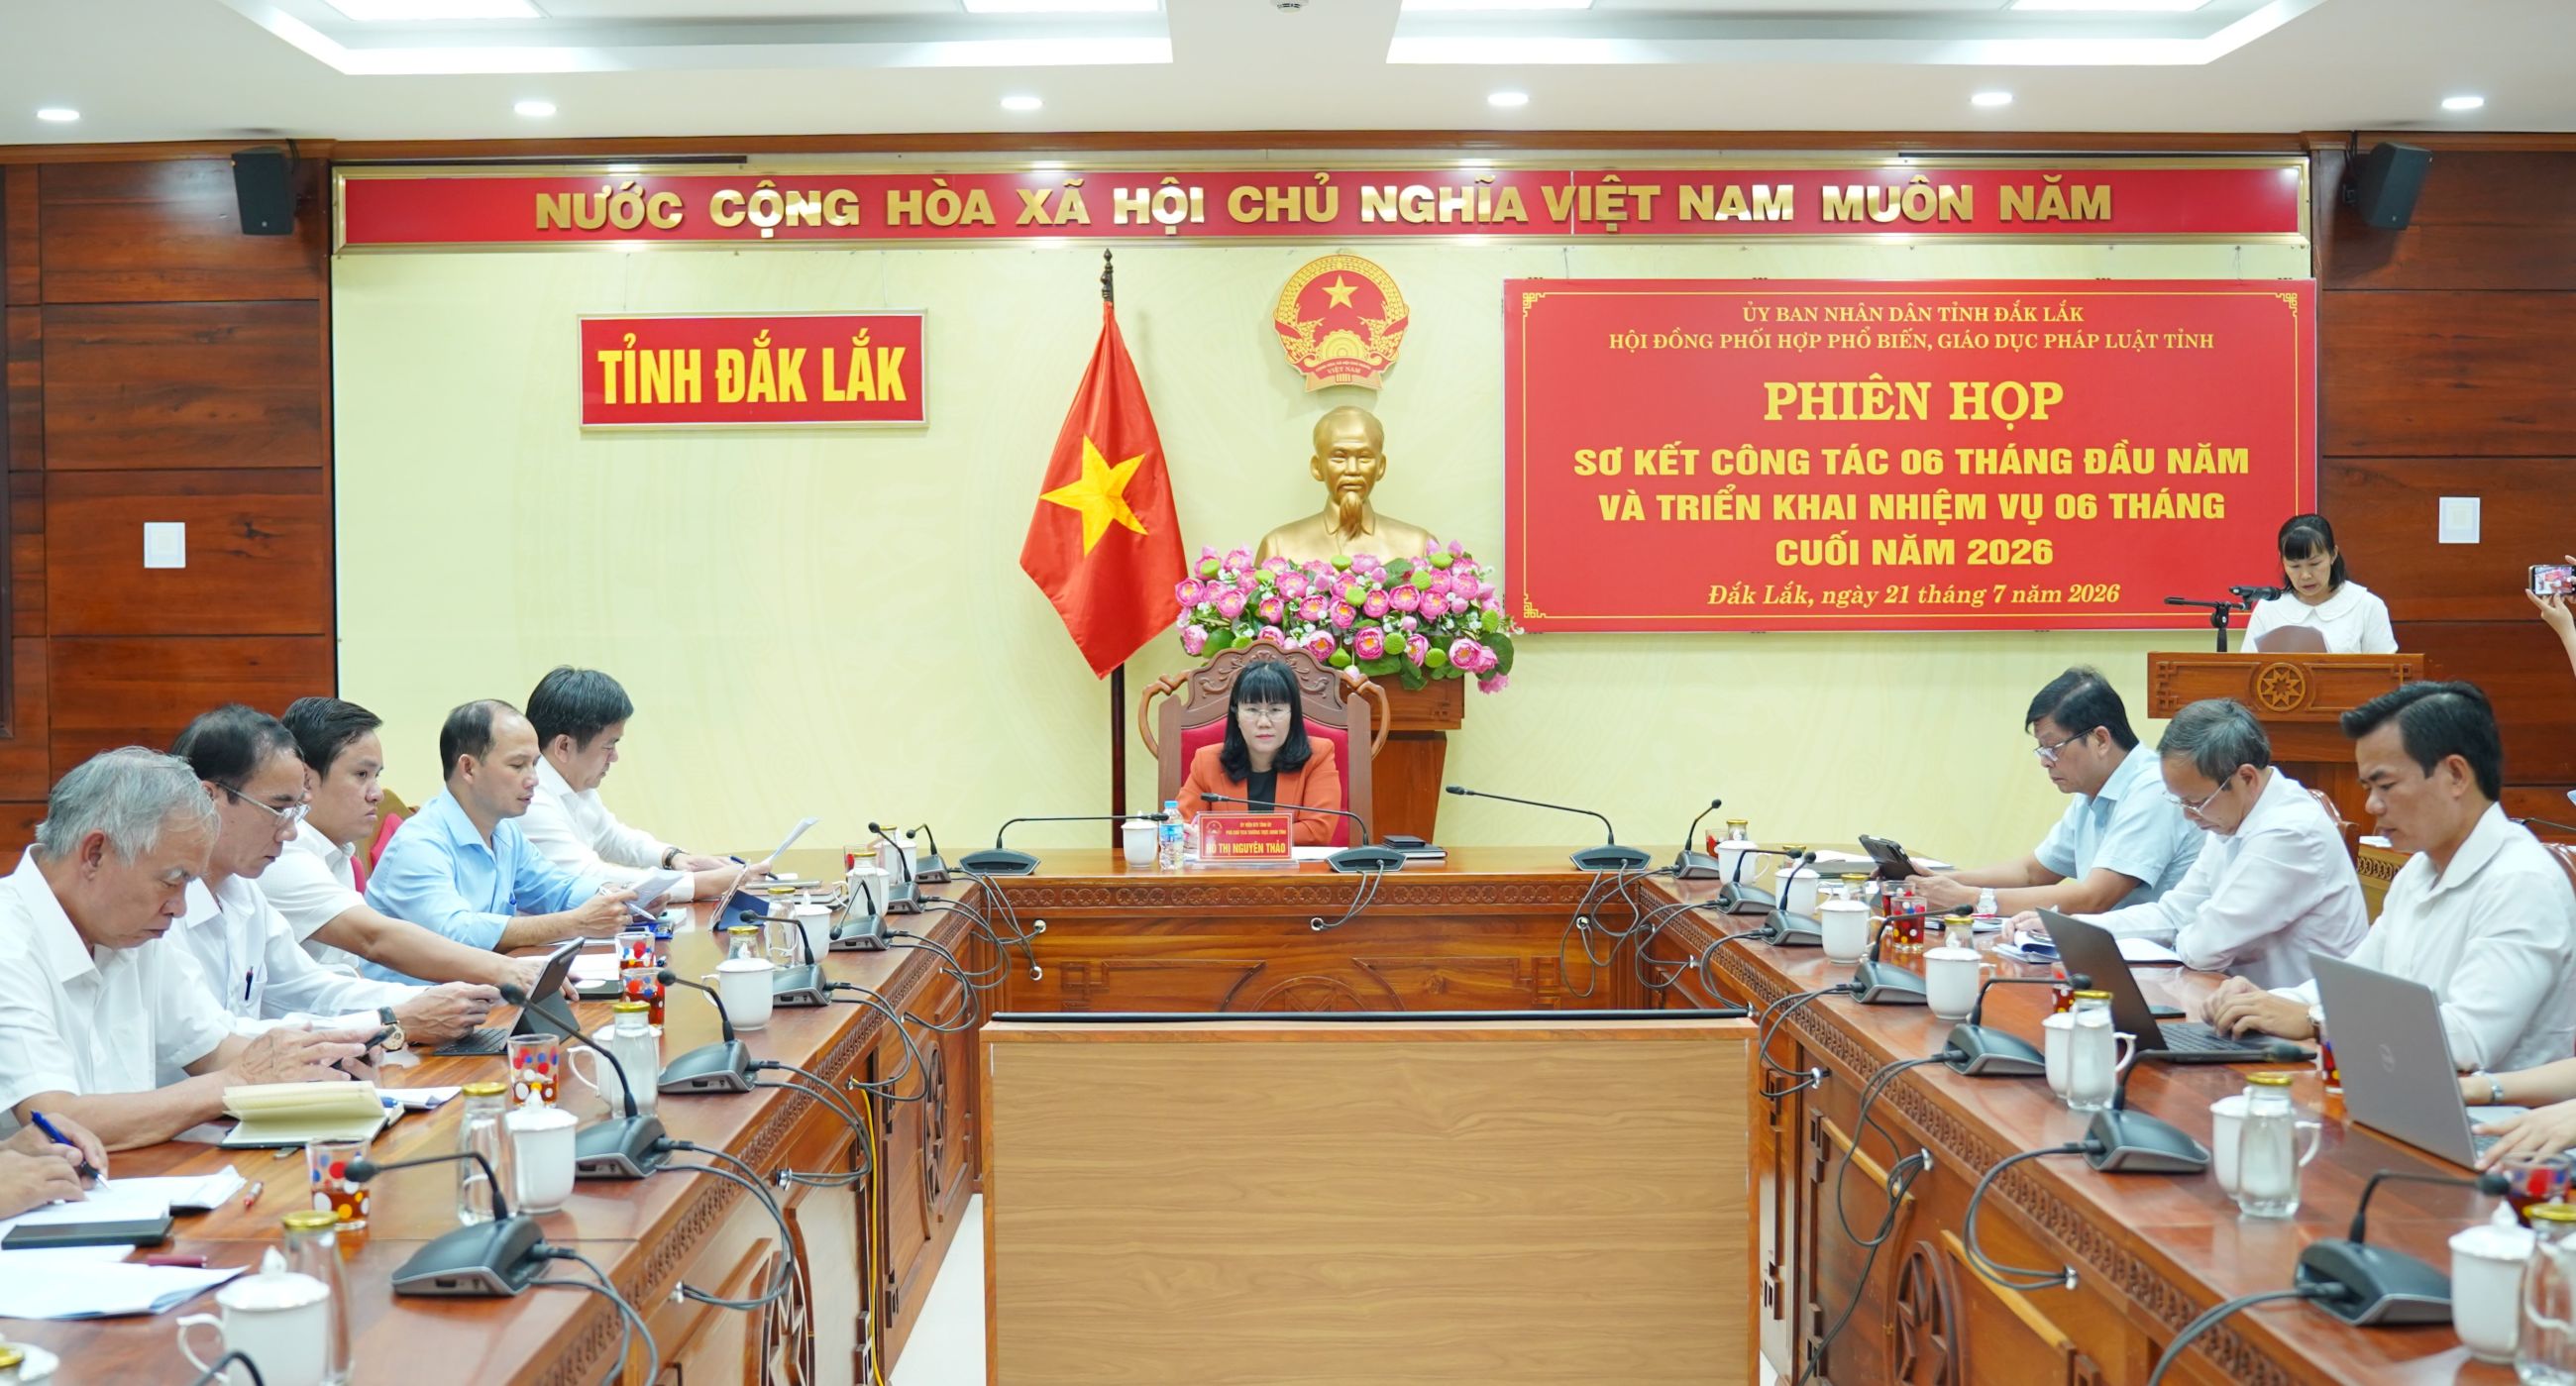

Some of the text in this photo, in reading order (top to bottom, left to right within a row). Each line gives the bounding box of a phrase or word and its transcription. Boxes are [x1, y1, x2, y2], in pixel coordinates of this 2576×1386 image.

[536, 171, 2112, 238] NƯỚC CỘNG HÒA XÃ HỘI CHỦ NGHĨA VIỆT NAM MUÔN NĂM
[1743, 298, 2084, 322] ỦY BAN NHÂN DÂN TỈNH ĐẮK LẮK
[1609, 325, 2212, 354] HỘI ĐỒNG PHỐI HỢP PHỔ BIẾN, GIÁO DỤC PHÁP LUẬT TỈNH
[597, 327, 907, 404] TỈNH ĐẮK LẮK
[1764, 373, 2064, 431] PHIÊN HỌP
[1573, 438, 2249, 477] SƠ KẾT CÔNG TÁC 06 THÁNG ĐẦU NĂM
[1598, 482, 2225, 526] VÀ TRIỂN KHAI NHIỆM VỤ 06 THÁNG
[1775, 529, 2054, 567] CUỐI NĂM 2026
[1707, 580, 2121, 609] Đắk Lắk, ngày 21 tháng 7 năm 2026
